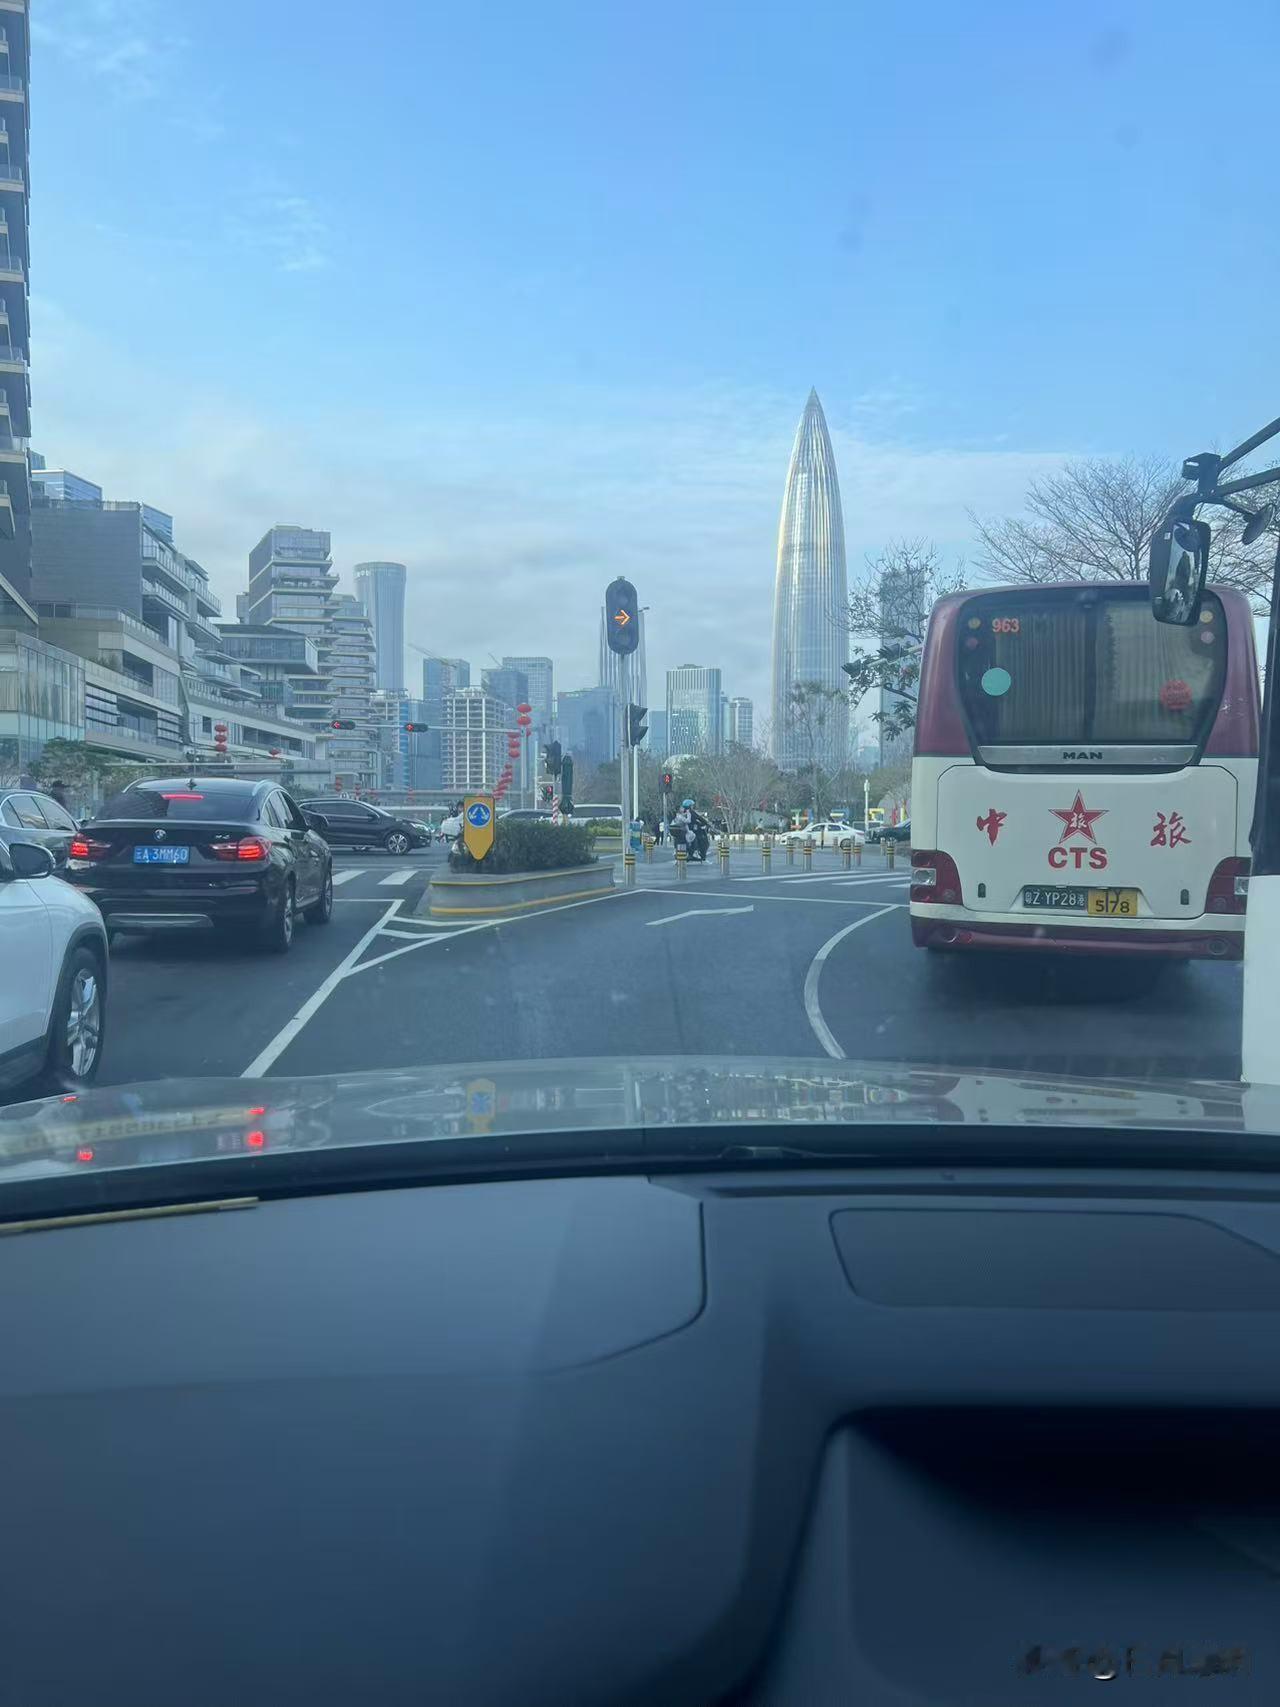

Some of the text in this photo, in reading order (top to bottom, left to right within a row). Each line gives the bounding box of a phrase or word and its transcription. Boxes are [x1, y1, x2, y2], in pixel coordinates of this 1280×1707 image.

[992, 617, 1020, 633] 963
[1063, 751, 1103, 760] MAN
[1047, 846, 1108, 870] CTS
